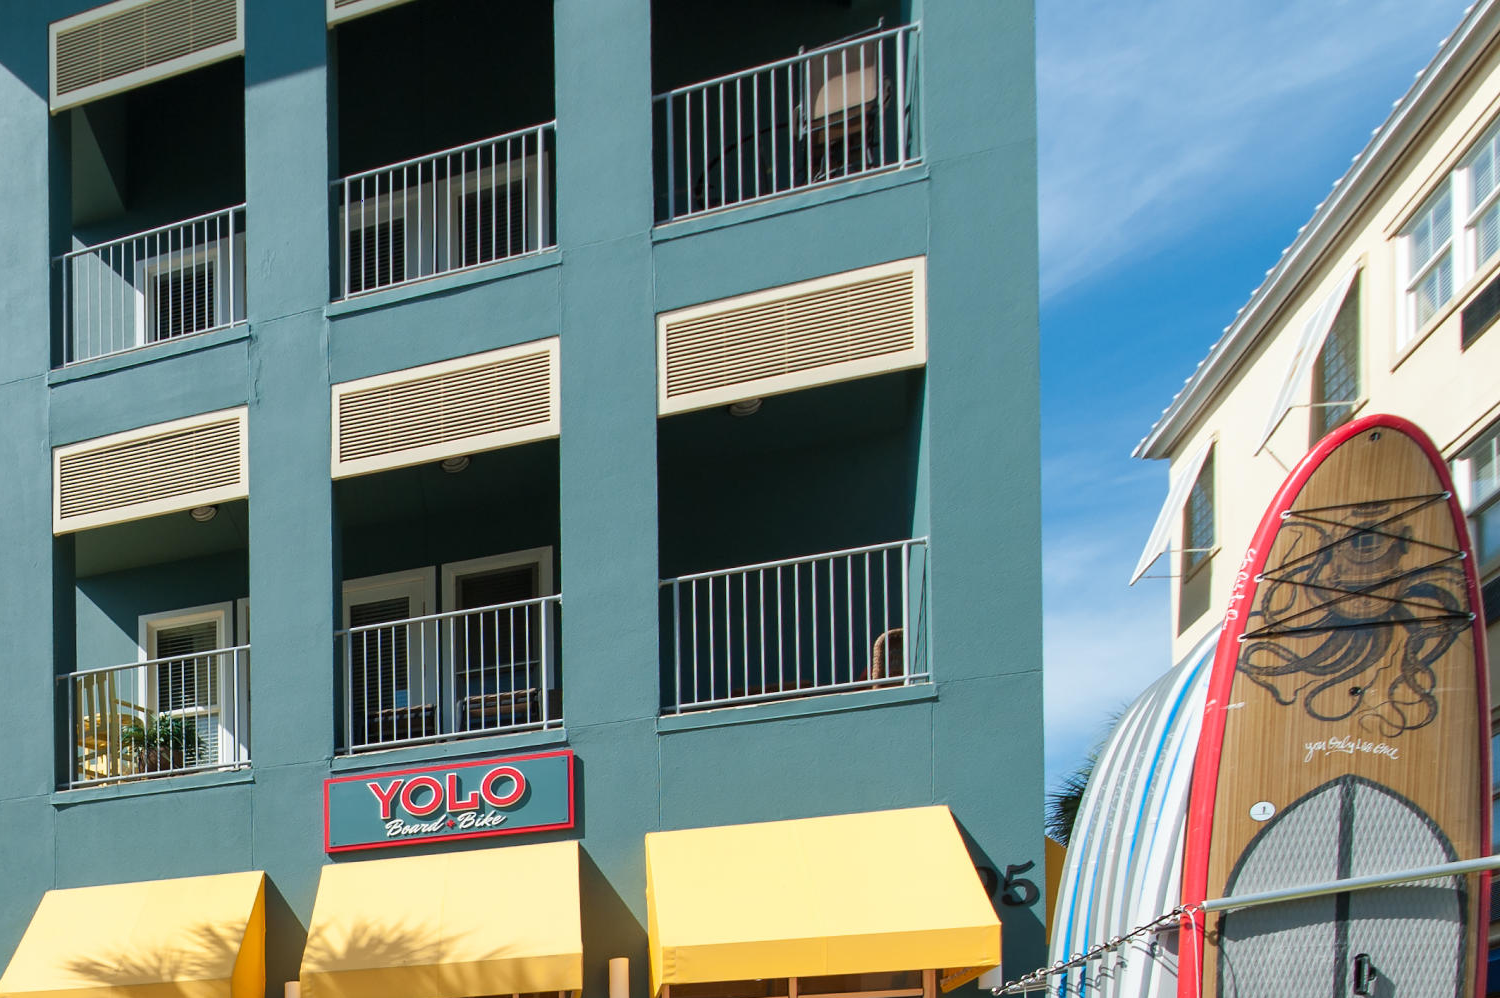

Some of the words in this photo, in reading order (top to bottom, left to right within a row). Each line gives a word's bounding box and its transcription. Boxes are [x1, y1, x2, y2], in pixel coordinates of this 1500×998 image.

[367, 765, 526, 820] YOLO
[384, 814, 447, 837] Board
[457, 810, 506, 830] Bike
